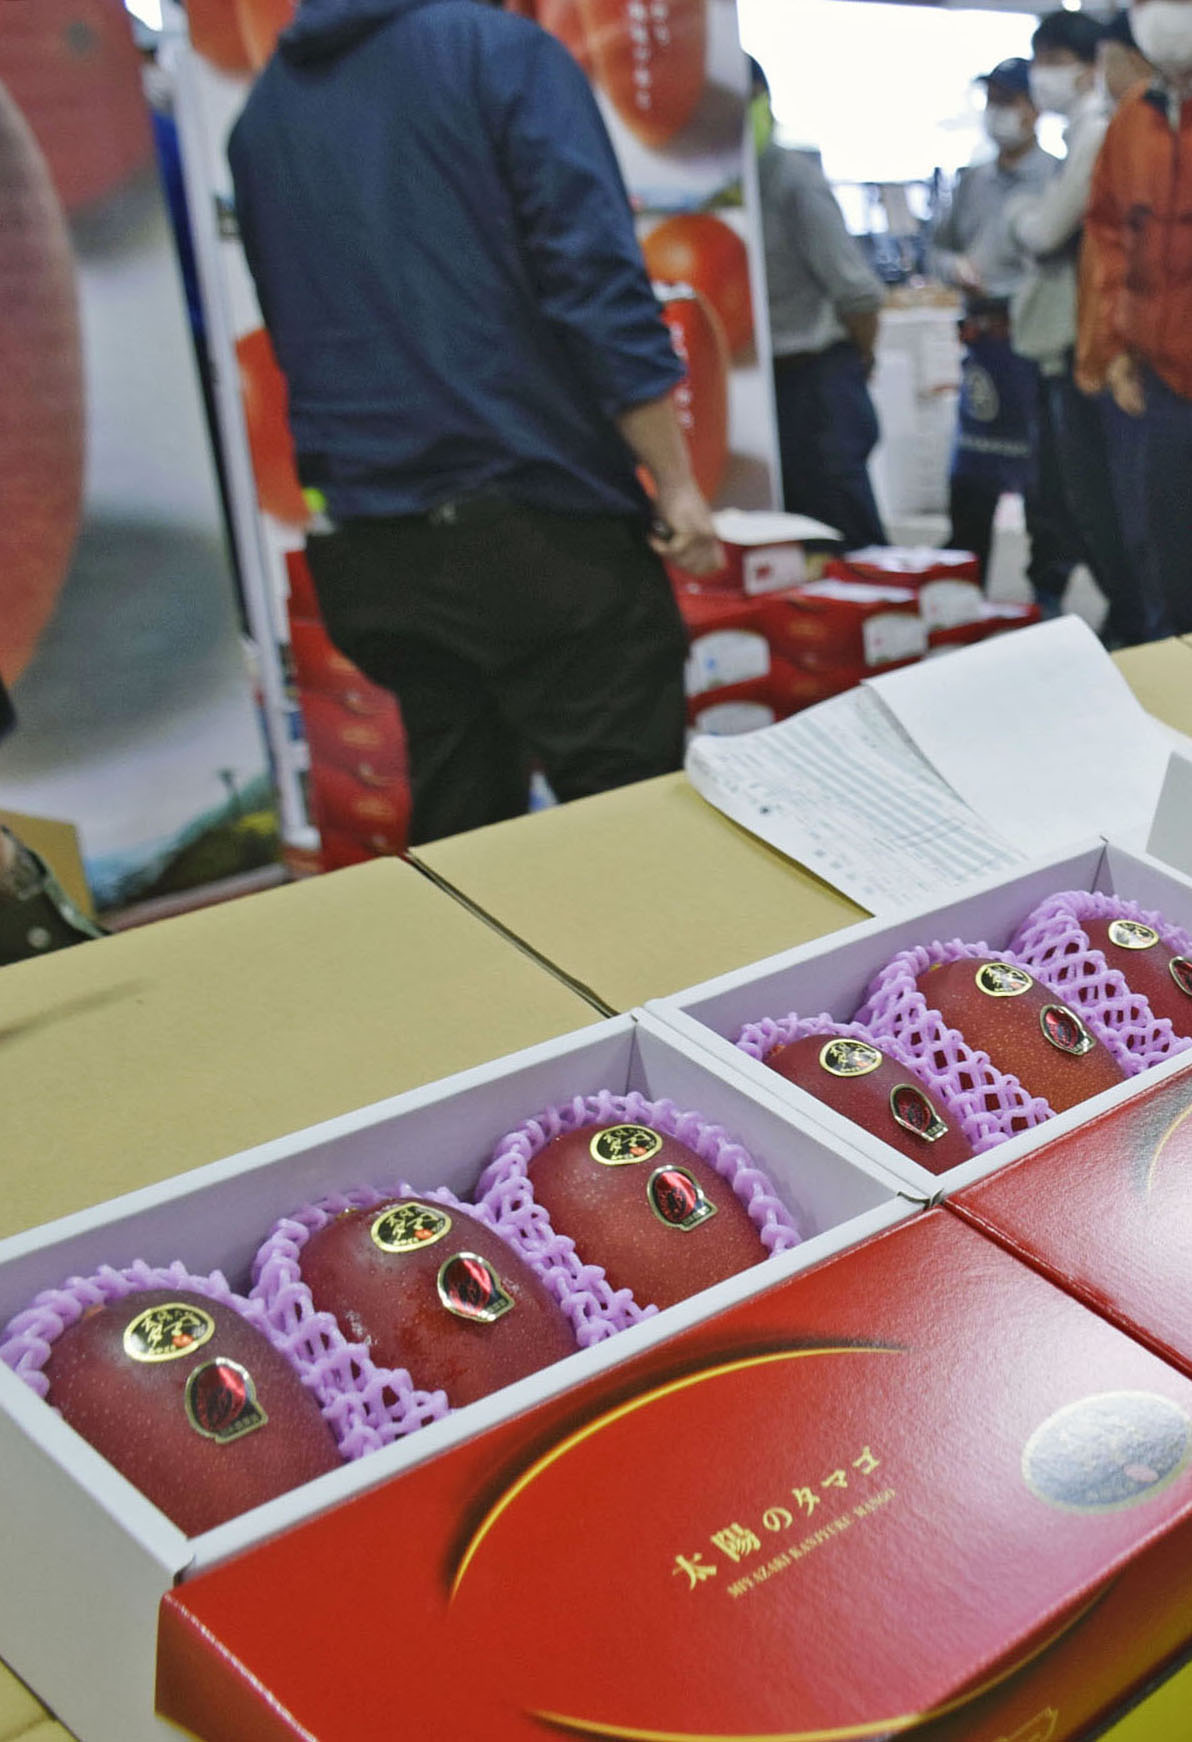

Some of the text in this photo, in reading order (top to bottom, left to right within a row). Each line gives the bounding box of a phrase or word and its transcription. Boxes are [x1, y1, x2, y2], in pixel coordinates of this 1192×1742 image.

[672, 1446, 880, 1590] 太陽のタマゴ
